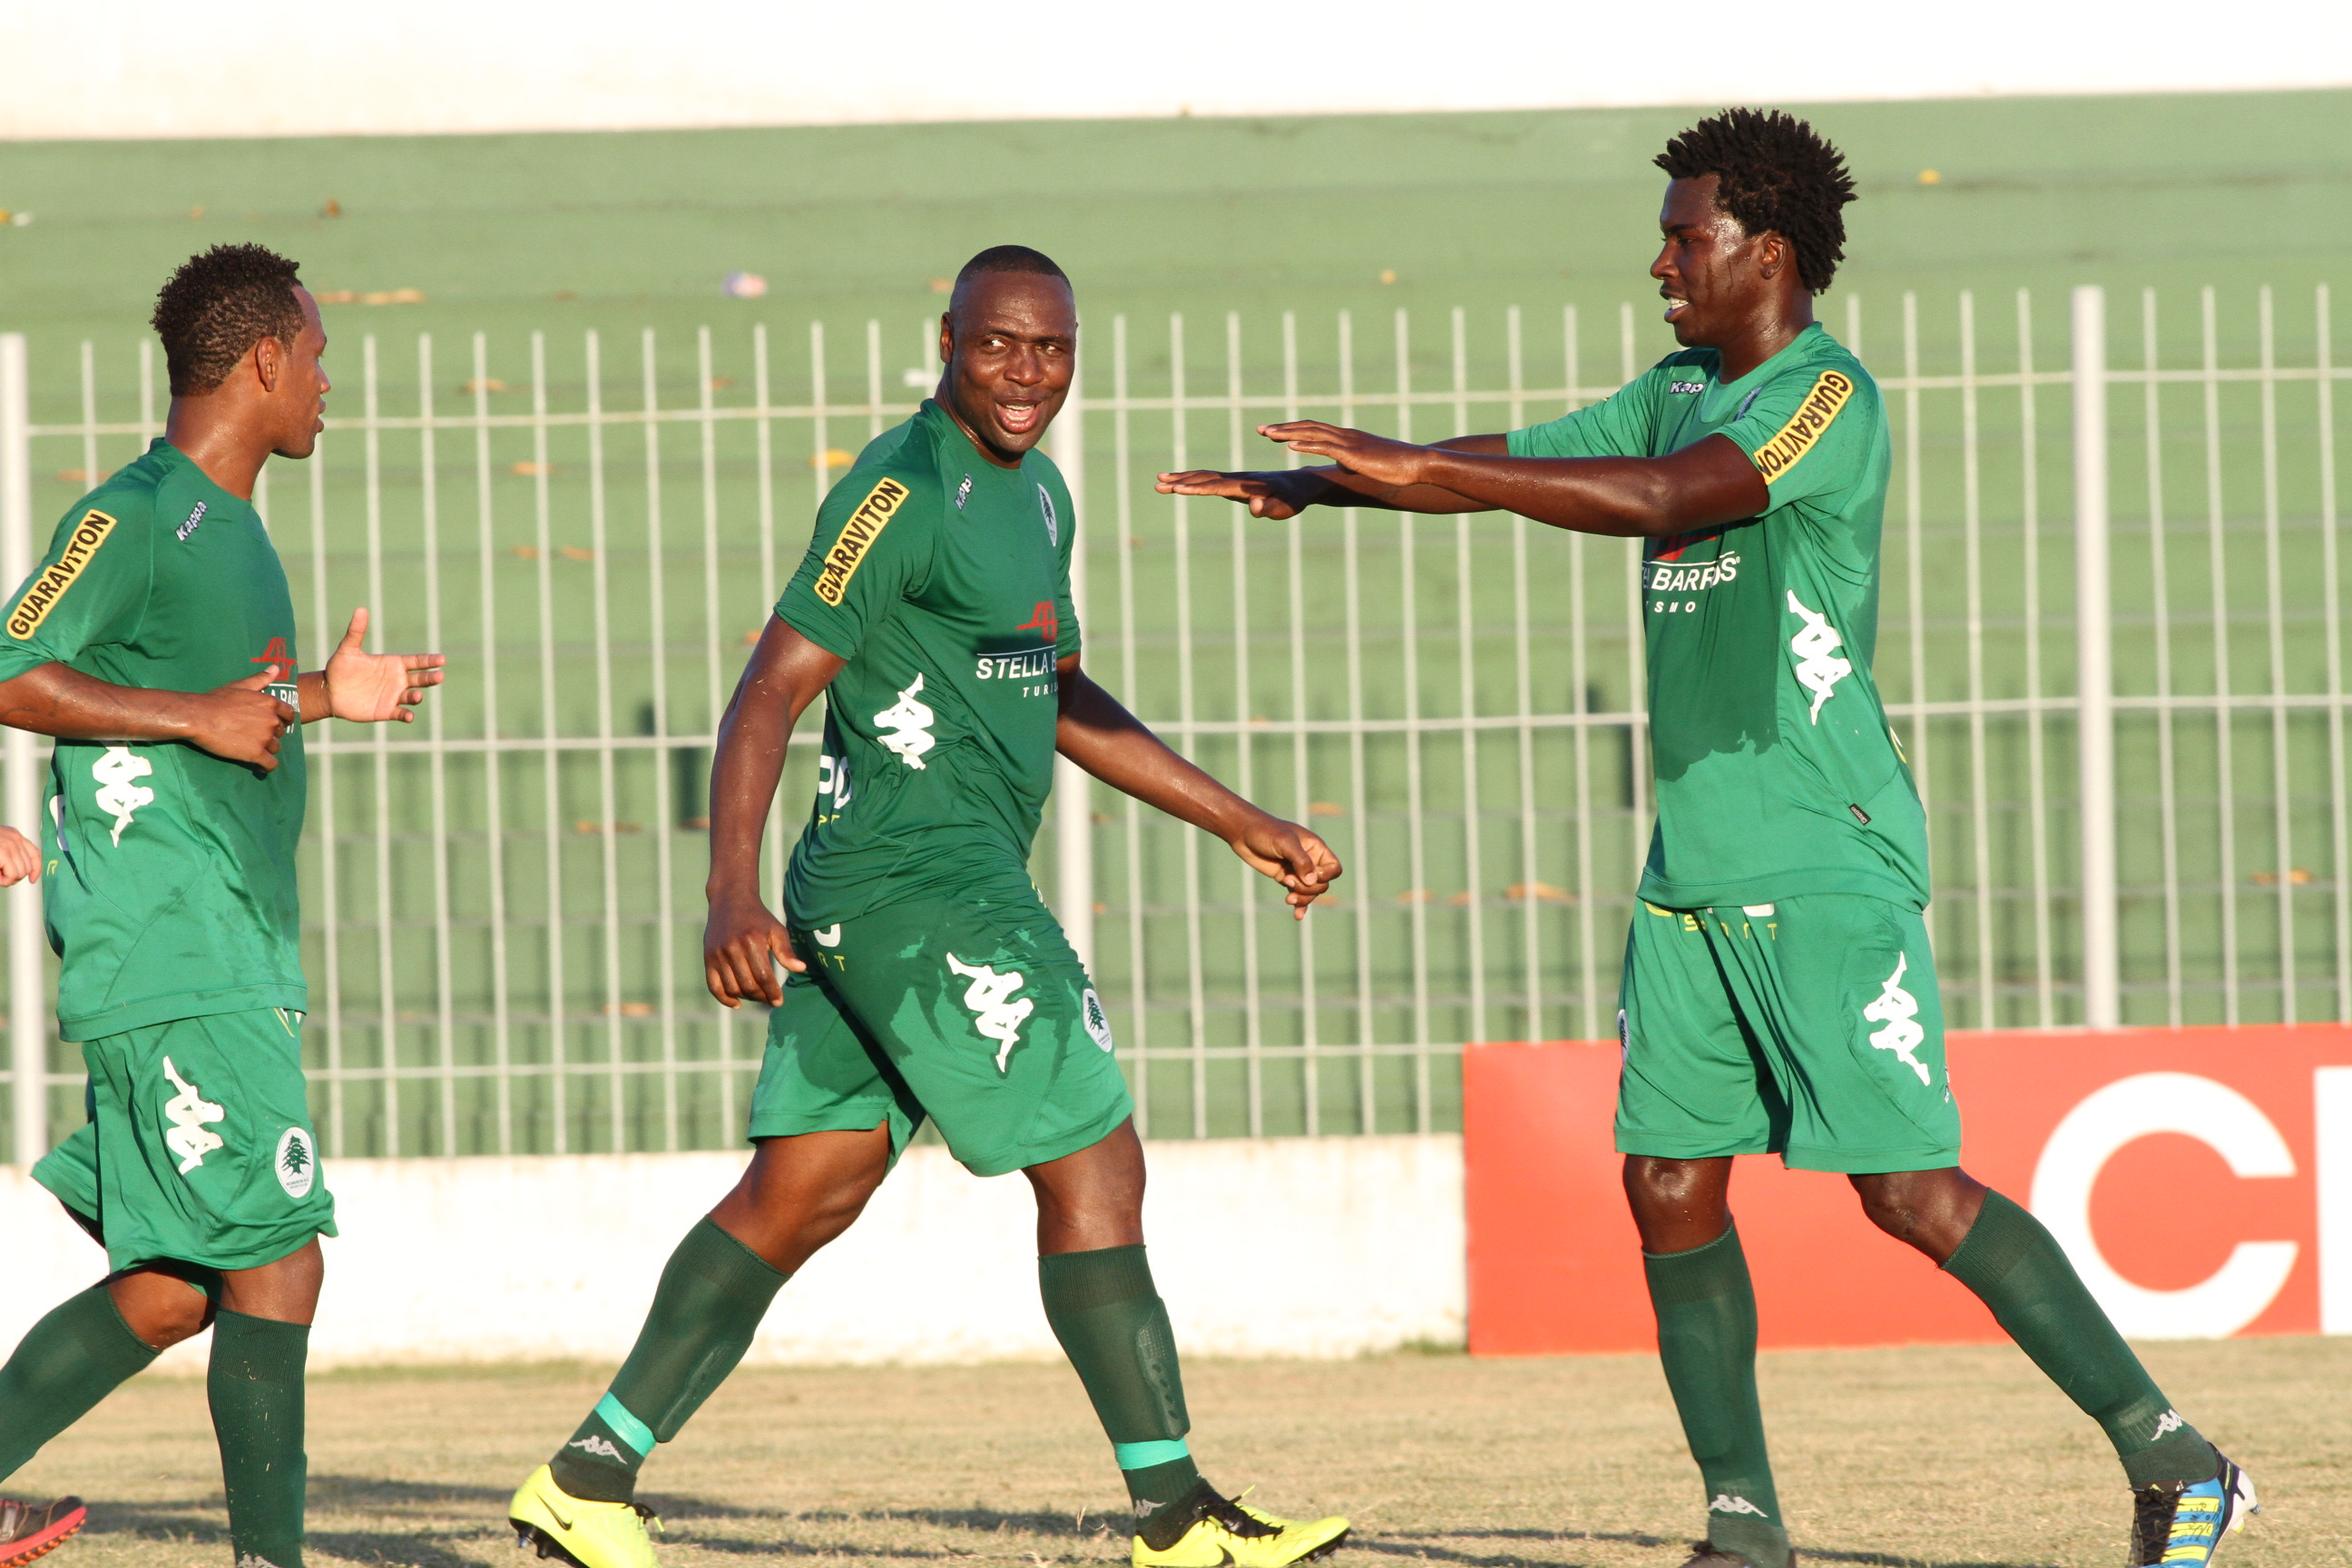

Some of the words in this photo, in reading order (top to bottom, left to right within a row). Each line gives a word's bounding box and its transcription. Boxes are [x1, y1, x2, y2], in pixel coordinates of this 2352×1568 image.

[175, 500, 208, 542] Kappa
[818, 481, 905, 602] GUARAVITON
[10, 513, 111, 635] GUARAVITON
[975, 652, 1049, 680] STELLA
